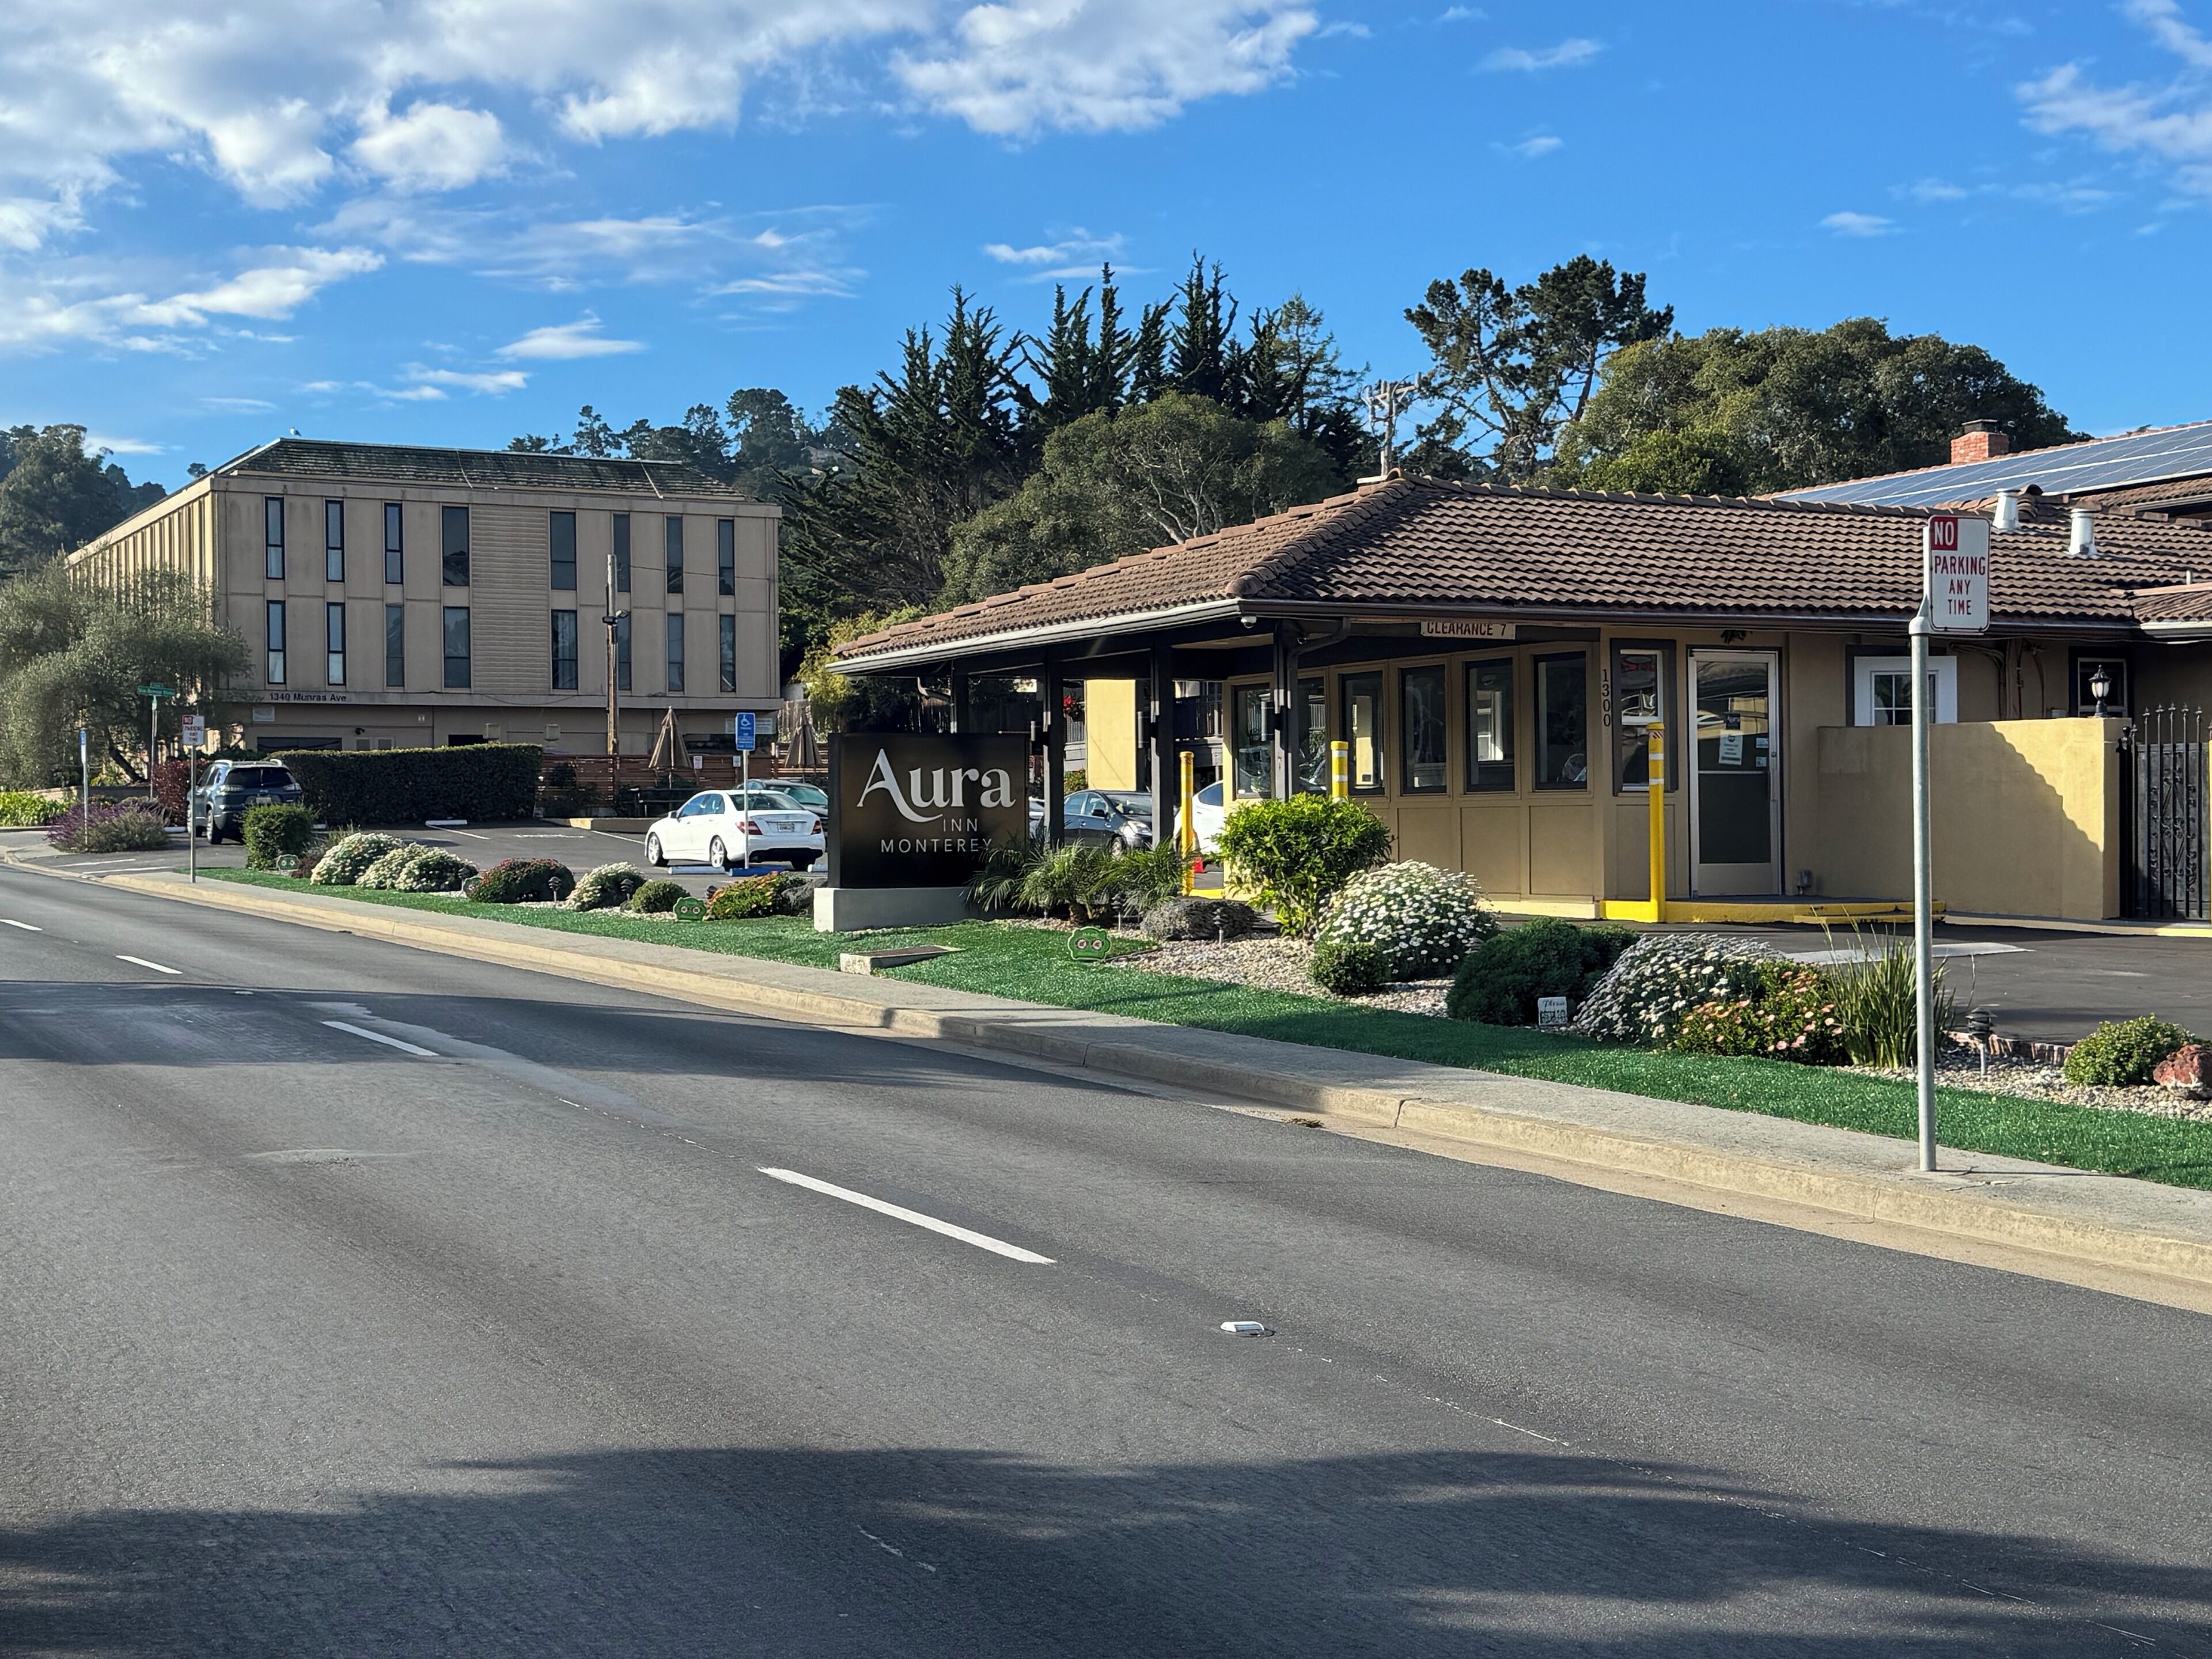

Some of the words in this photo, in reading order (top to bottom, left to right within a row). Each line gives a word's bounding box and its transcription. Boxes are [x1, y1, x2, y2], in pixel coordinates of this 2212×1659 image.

[1934, 521, 1955, 546] NO
[1934, 555, 1986, 575] PARKING
[1948, 578, 1971, 595] ANY
[1947, 599, 1972, 615] TIME
[1427, 622, 1494, 637] CLEARANCE
[270, 692, 291, 701] 1340
[329, 694, 347, 702] Ave
[1601, 668, 1611, 728] 1300
[856, 748, 1017, 823] Aura
[942, 817, 978, 832] INN
[880, 838, 993, 854] MONTEREY
